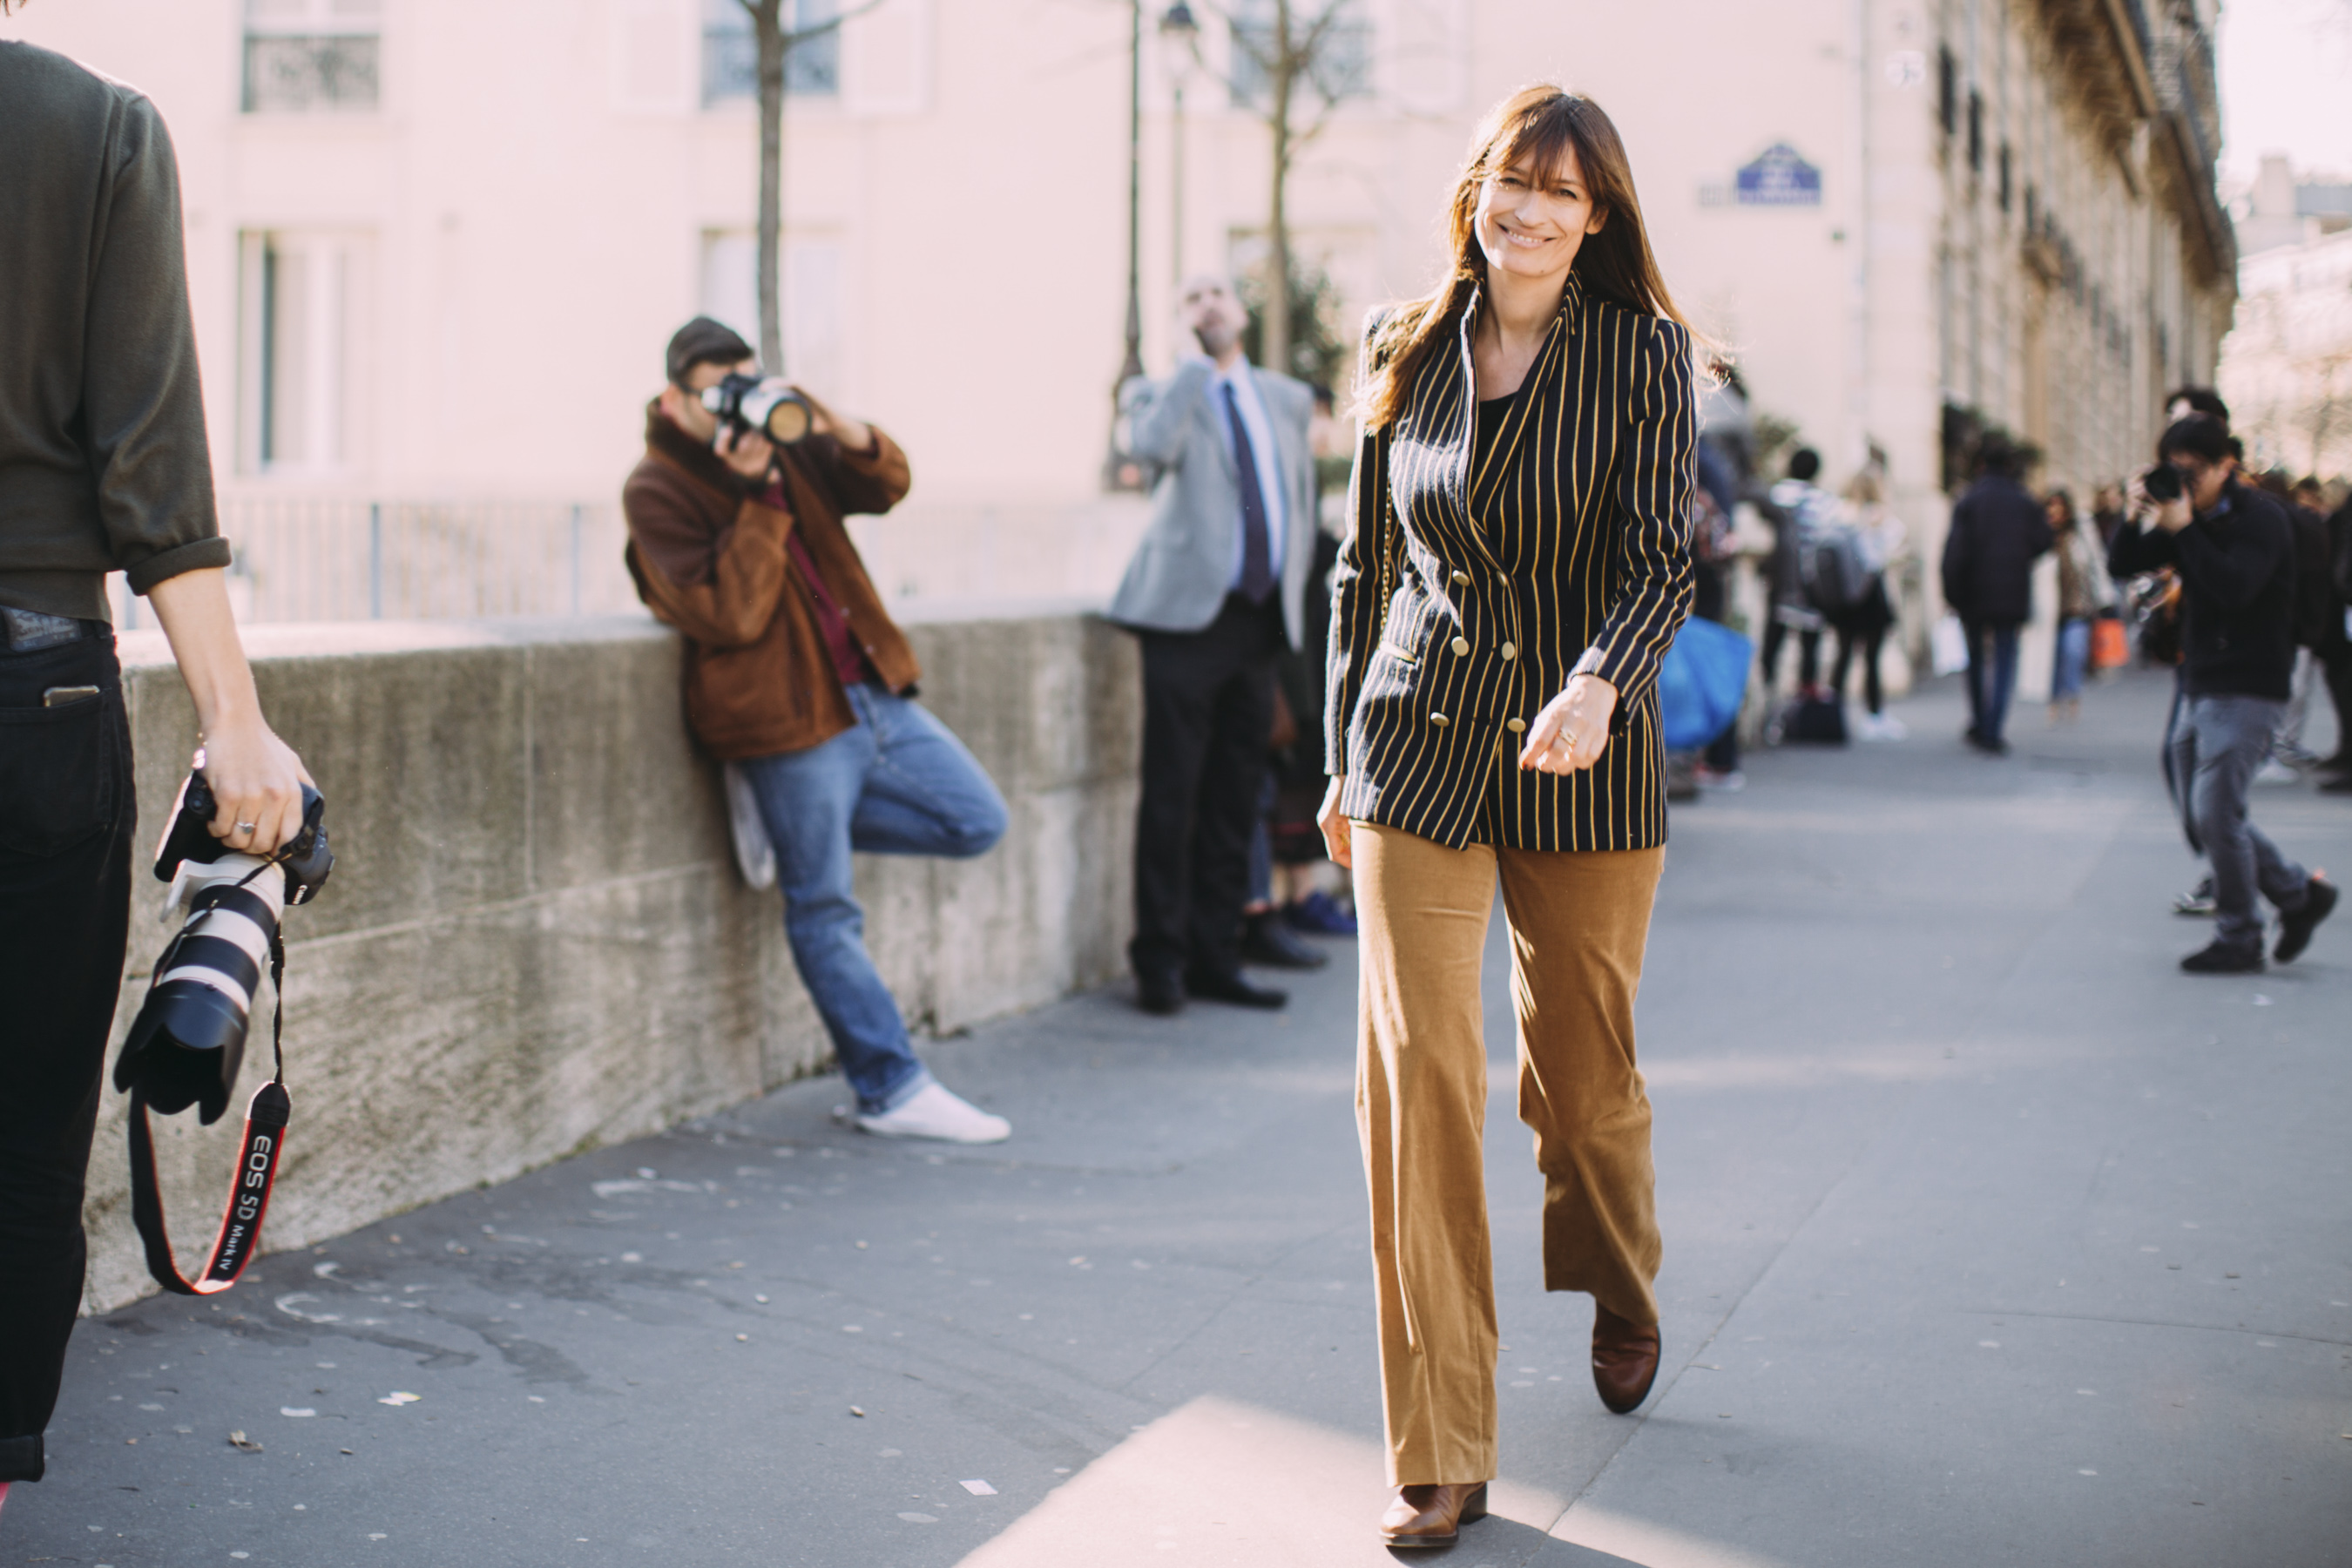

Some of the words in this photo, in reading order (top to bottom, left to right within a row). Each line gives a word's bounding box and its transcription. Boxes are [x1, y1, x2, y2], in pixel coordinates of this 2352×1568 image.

[245, 1135, 272, 1188] EOS
[237, 1193, 259, 1220] 5D
[223, 1224, 245, 1256] Mark
[219, 1258, 233, 1270] IV
